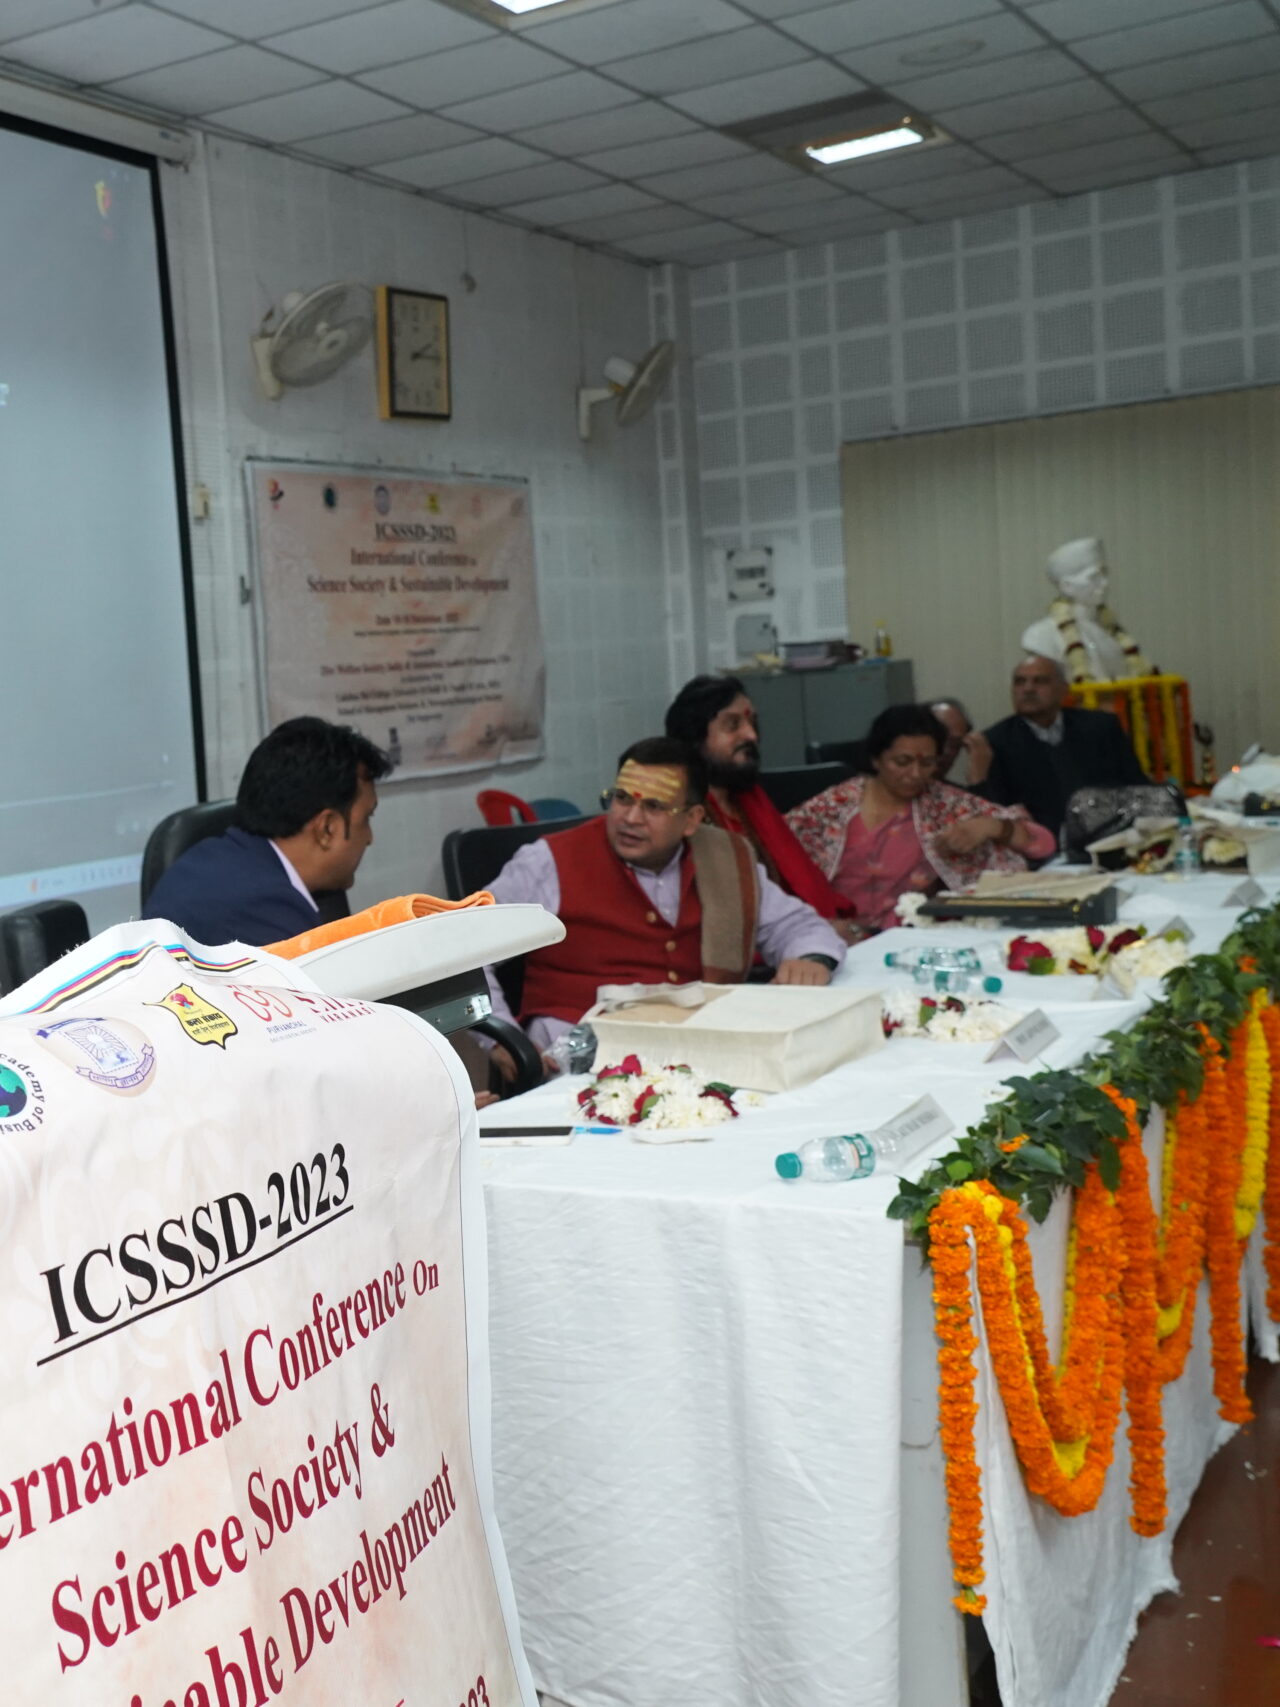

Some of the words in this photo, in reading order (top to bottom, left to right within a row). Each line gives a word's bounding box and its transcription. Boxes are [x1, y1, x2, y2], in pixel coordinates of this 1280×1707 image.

[40, 1142, 352, 1345] ICSSSD-2023
[242, 1261, 407, 1407] Conference
[412, 1259, 440, 1297] On
[50, 1514, 249, 1674] Science
[247, 1418, 362, 1555] Society
[369, 1381, 396, 1457] &
[278, 1450, 457, 1675] Development
